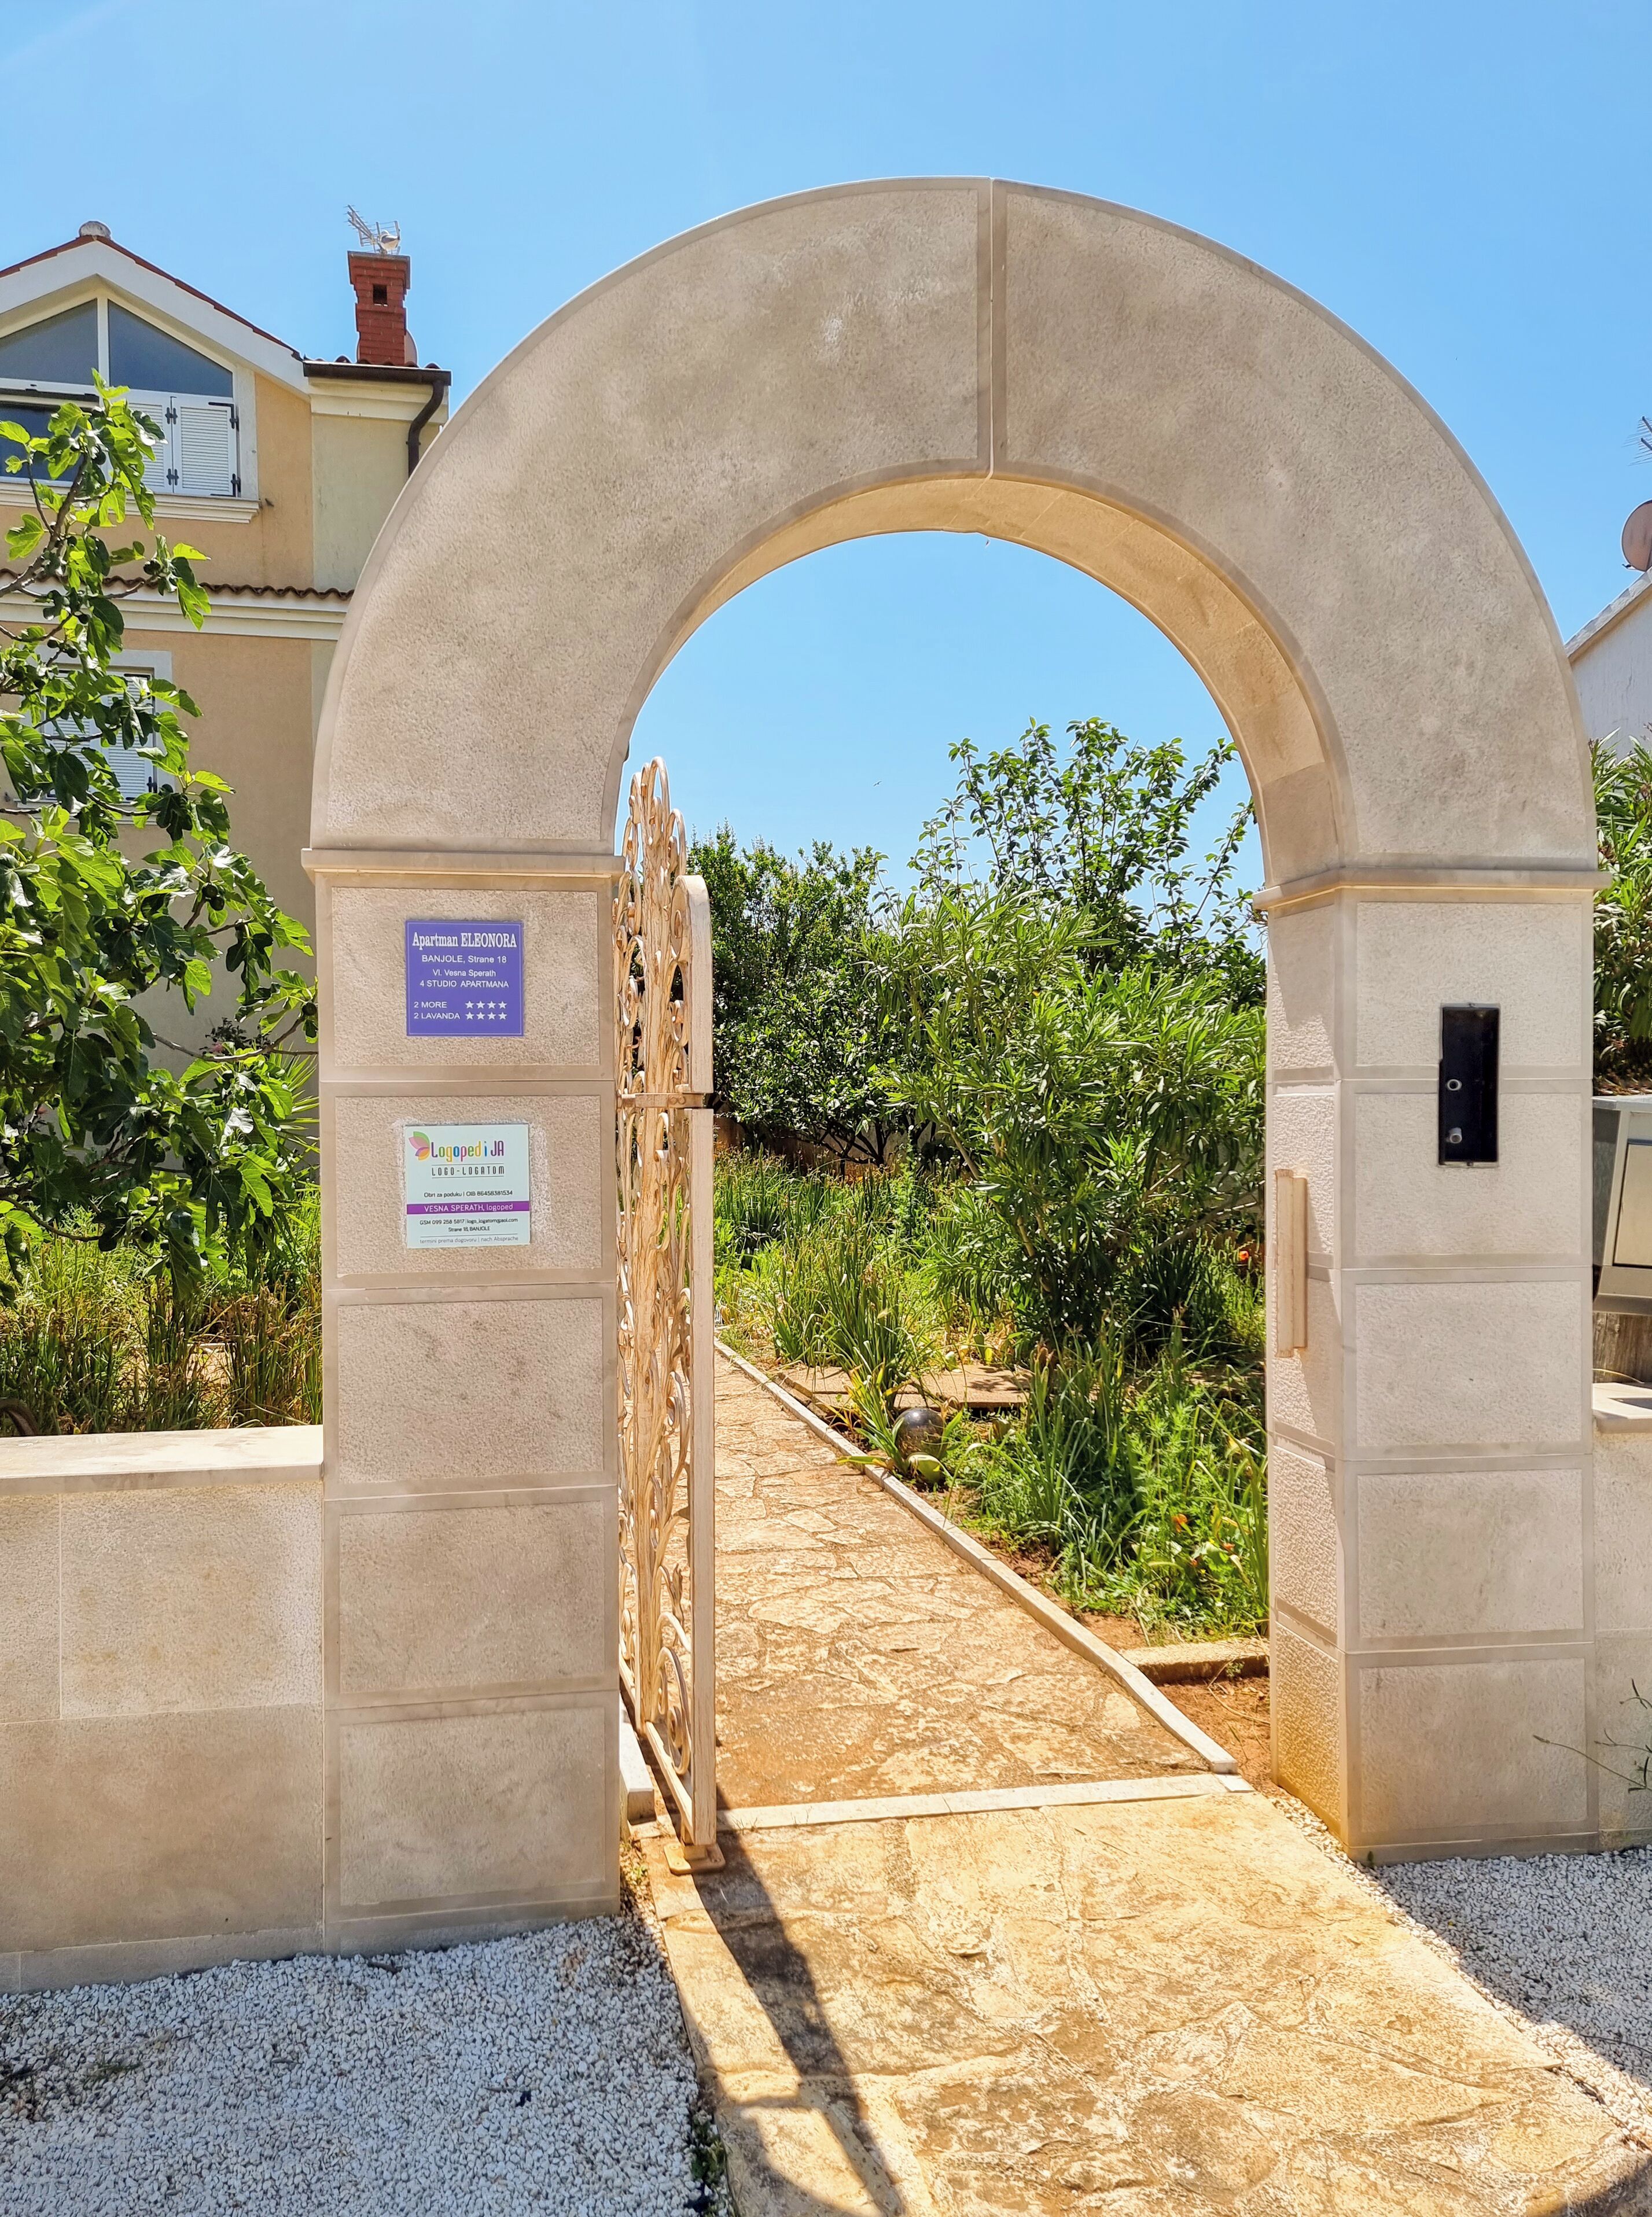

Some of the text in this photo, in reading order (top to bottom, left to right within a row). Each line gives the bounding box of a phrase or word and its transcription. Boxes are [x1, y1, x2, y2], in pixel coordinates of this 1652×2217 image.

[413, 932, 517, 950] Apartman ELEONORA
[422, 955, 465, 963] BANJOLE,
